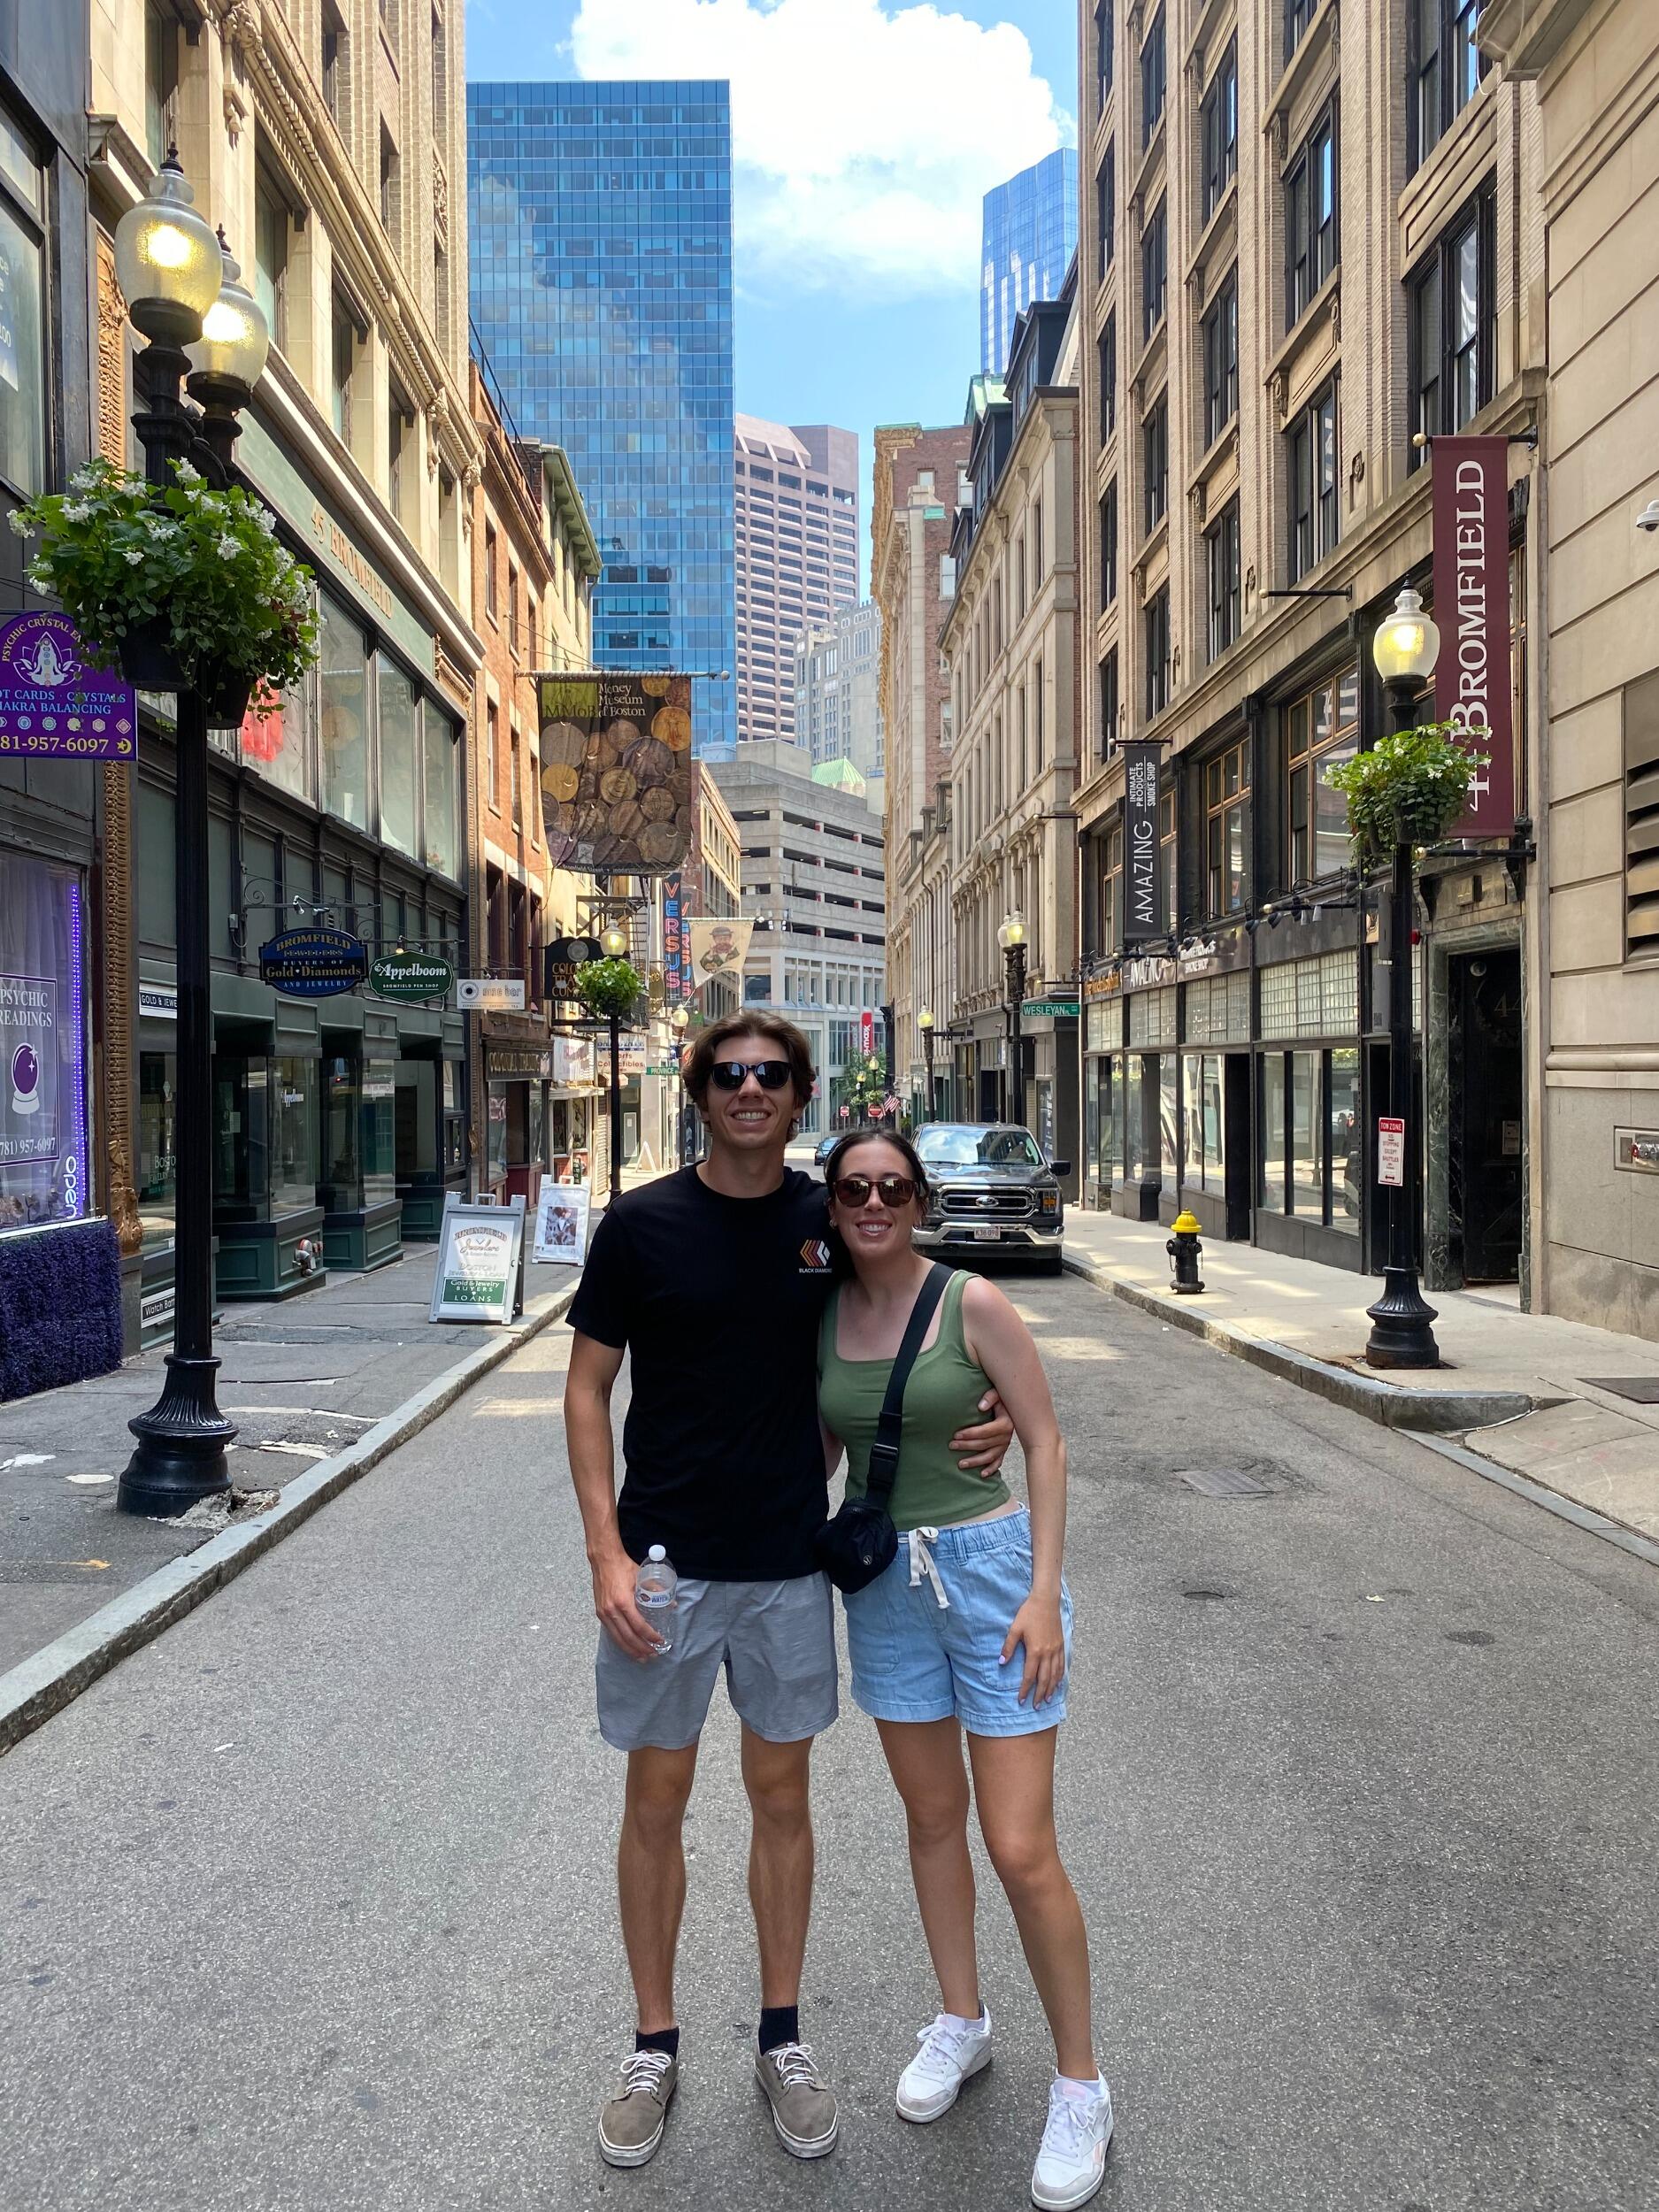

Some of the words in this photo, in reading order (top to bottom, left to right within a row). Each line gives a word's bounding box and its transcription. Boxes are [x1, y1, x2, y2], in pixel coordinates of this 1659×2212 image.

[330, 523, 393, 619] BROMFIELD
[1449, 460, 1488, 742] BROMFIELD
[2, 624, 27, 662] PSYCHIC
[27, 618, 69, 634] CRYSTAL
[14, 689, 55, 700] CARDS
[66, 691, 126, 703] CYSTALS
[598, 683, 632, 696] Money
[0, 701, 36, 712] AKRA
[41, 703, 111, 715] BALANCING
[598, 695, 643, 706] Museum
[610, 707, 646, 717] Boston
[0, 735, 109, 753] 81-957-6097
[1147, 762, 1156, 781] SHOP
[1135, 762, 1144, 807] PRODUCTS
[1147, 781, 1156, 807] SMOKE
[1133, 819, 1154, 924] AMAZING
[276, 934, 351, 951] BROMFIELD
[664, 881, 680, 988] VERSUS
[265, 967, 295, 978] Gold
[301, 964, 362, 977] Diamonds
[374, 963, 448, 980] Appelboom
[0, 988, 49, 1007] PSYCHIC
[142, 995, 156, 1004] GOLD
[164, 998, 177, 1008] JEWE
[1024, 1005, 1064, 1015] WESLEYAN
[1390, 1123, 1402, 1132] ZONE
[19, 1136, 56, 1153] 957-6097
[155, 1156, 176, 1169] BOSTO
[64, 1156, 78, 1219] open
[144, 1303, 164, 1316] Watch
